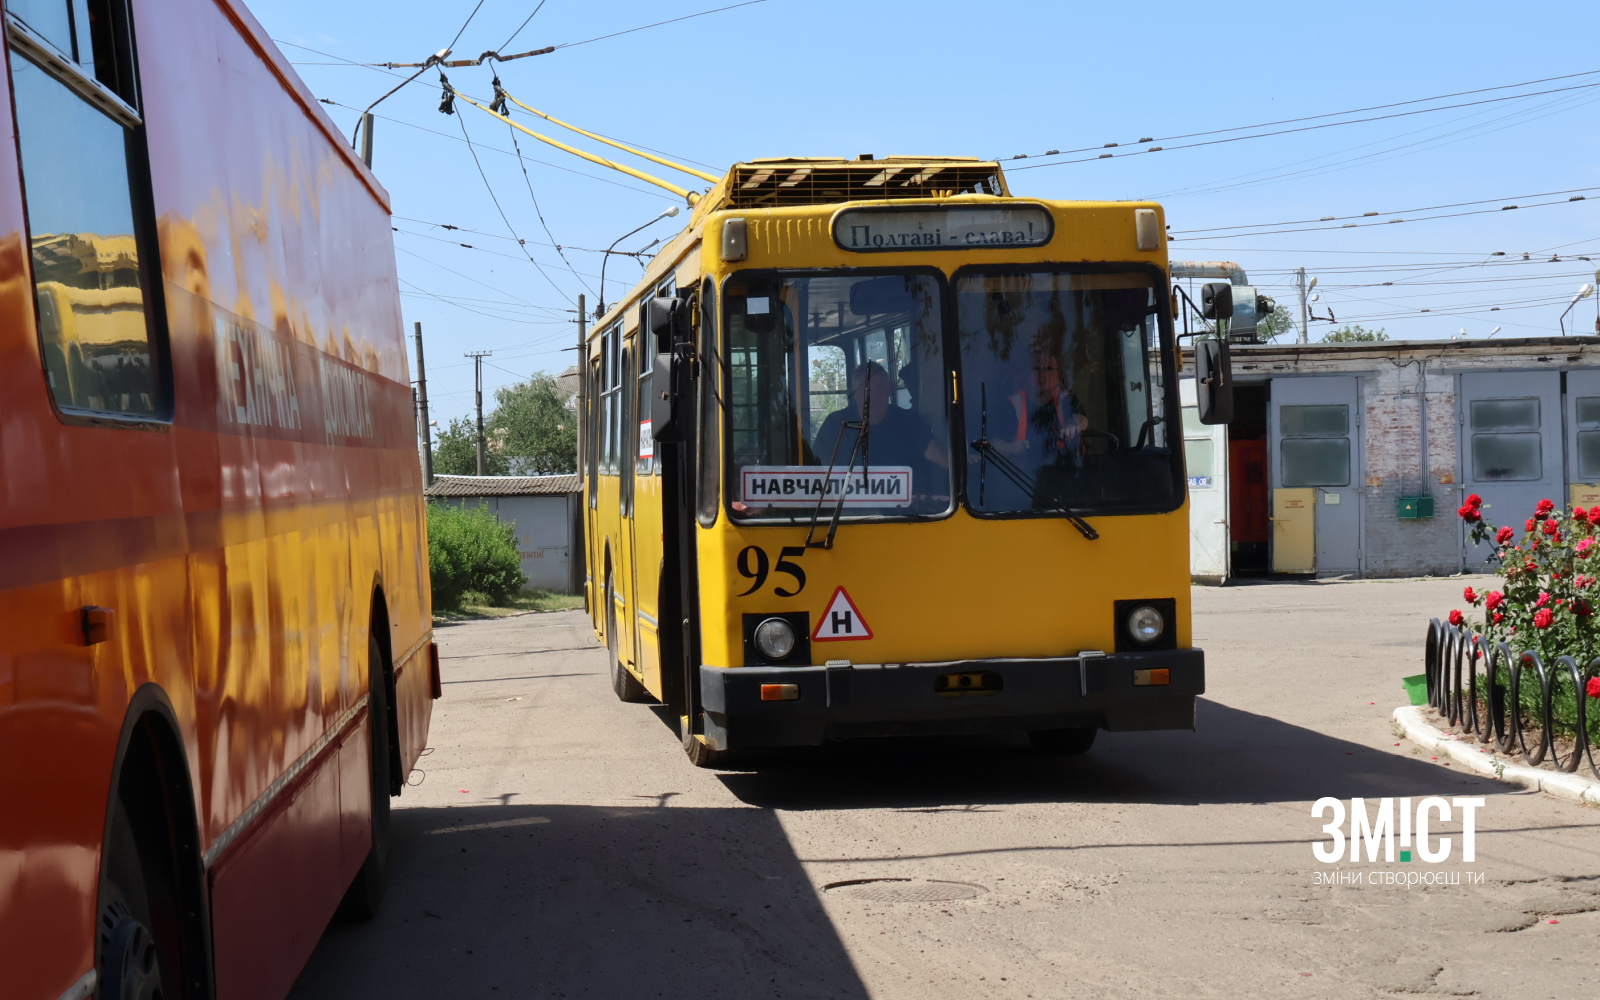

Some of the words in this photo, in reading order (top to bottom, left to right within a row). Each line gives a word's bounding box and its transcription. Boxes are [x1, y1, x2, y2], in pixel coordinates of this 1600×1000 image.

[851, 225, 942, 248] Полтаві
[965, 221, 1035, 246] слава!
[215, 317, 302, 430] ТЕХНІЧНА
[752, 476, 901, 495] НАВЧАЛЬНИЙ
[737, 545, 807, 597] 95
[831, 611, 852, 633] Н
